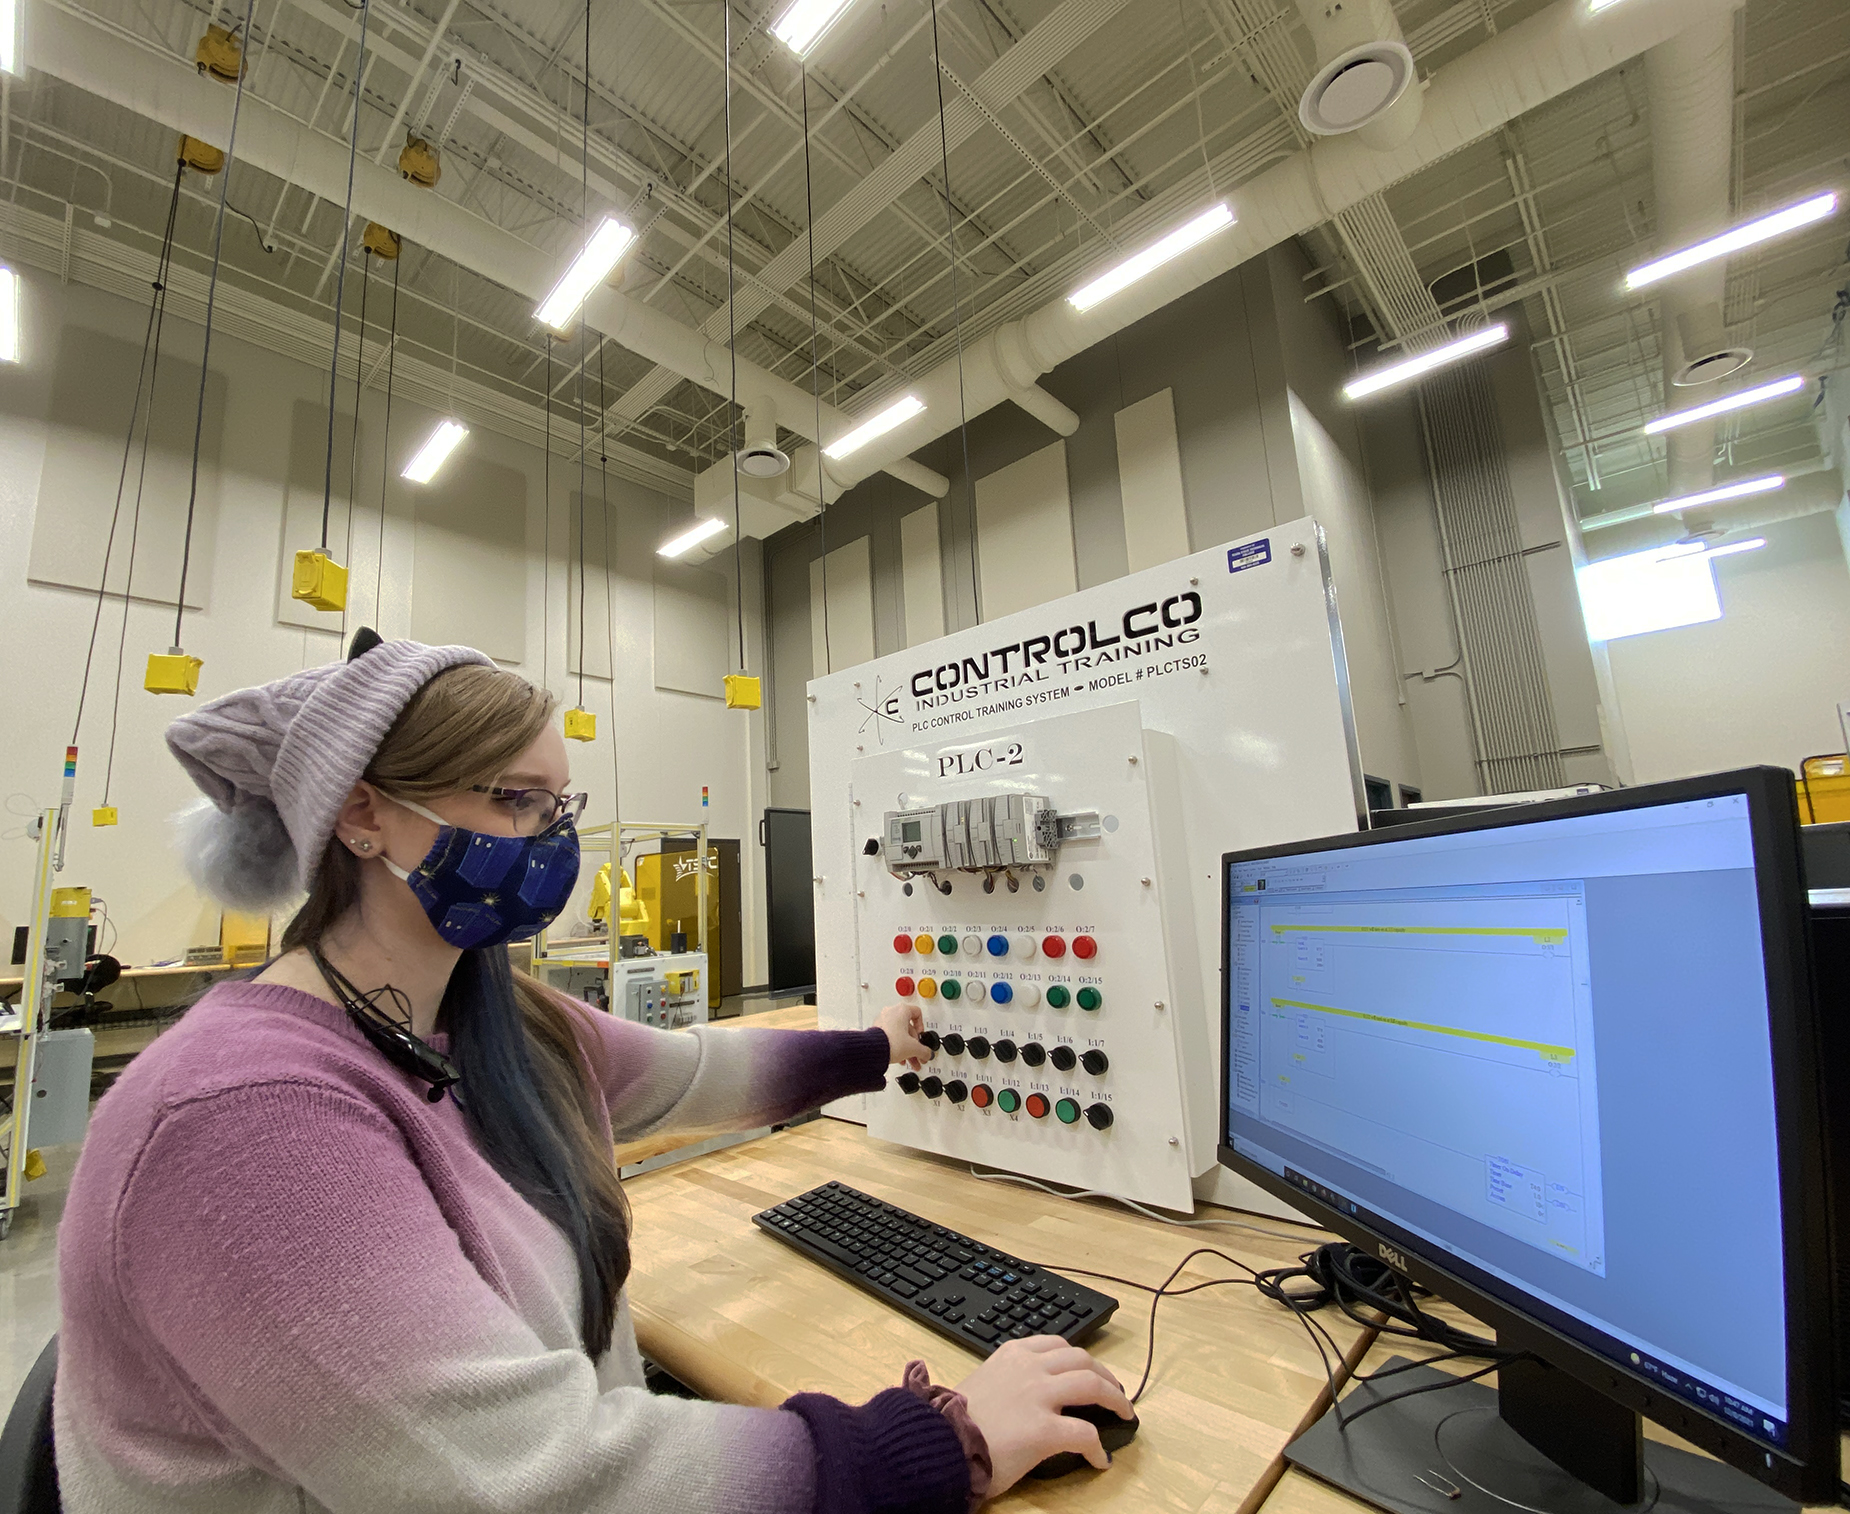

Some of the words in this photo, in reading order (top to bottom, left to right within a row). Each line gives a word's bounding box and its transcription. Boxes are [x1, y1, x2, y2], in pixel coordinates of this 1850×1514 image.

[911, 591, 1203, 698] CONTROLCO
[916, 669, 1049, 712] INDUSTRIAL
[1057, 628, 1200, 675] TRAINING
[912, 720, 929, 733] PLC
[930, 710, 974, 728] CONTROL
[976, 698, 1023, 717] TRAINING
[1025, 686, 1070, 706] SYSTEM
[1089, 672, 1133, 692] MODEL
[1135, 669, 1143, 680] #
[1147, 654, 1207, 678] PLCTS02
[937, 742, 1024, 778] PLC-2
[1046, 925, 1064, 933] O:2/6
[1075, 925, 1095, 933] O:2/7
[1078, 976, 1103, 984] O:2/15
[1057, 1035, 1073, 1043] I:1/6
[1088, 1038, 1105, 1047] I:1/7
[1060, 1086, 1080, 1096] I:1/14
[1091, 1091, 1113, 1101] I:1/15
[1009, 1114, 1018, 1122] X4
[1378, 1243, 1408, 1272] DELL
